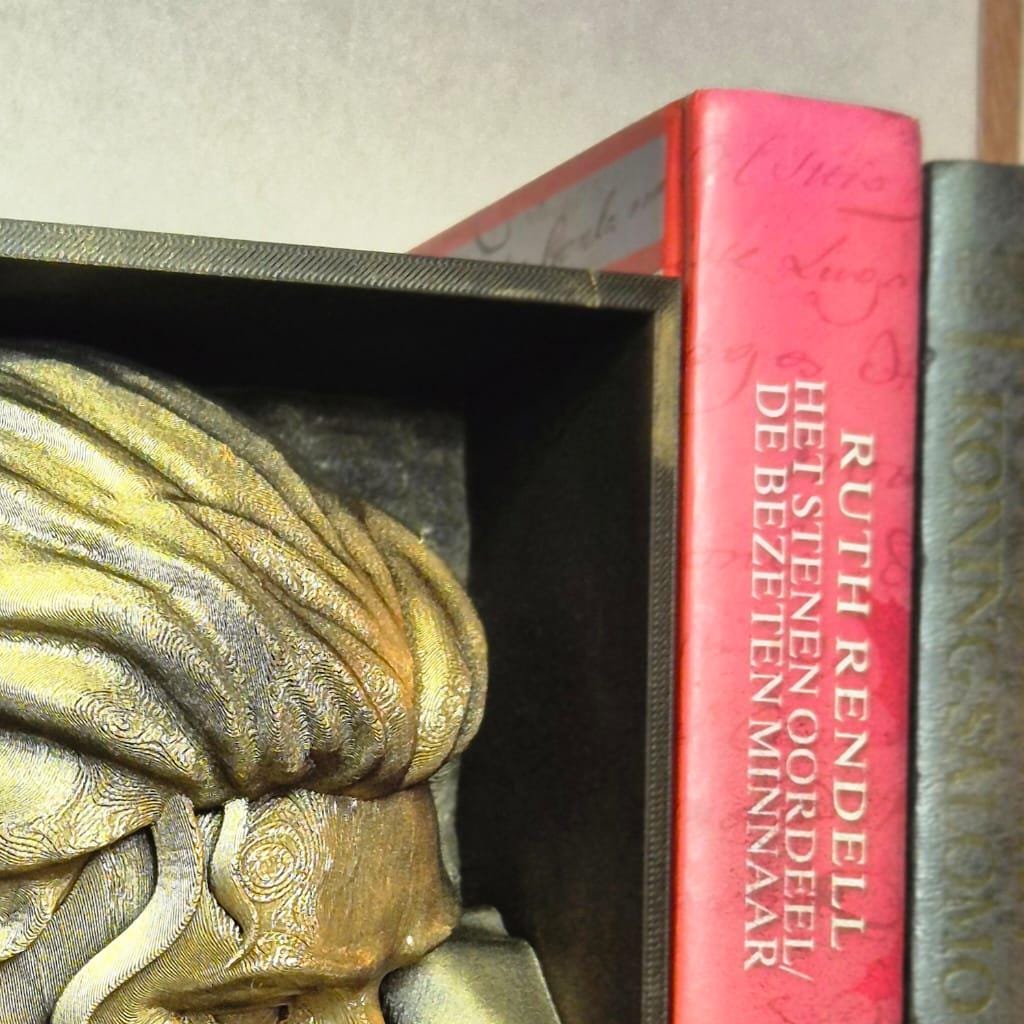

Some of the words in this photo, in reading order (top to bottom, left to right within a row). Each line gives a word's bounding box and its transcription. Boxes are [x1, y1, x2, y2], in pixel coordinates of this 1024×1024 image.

[753, 382, 790, 454] DE
[791, 378, 827, 486] HET
[835, 428, 875, 618] RUTH
[748, 465, 789, 705] BEZETEN
[787, 493, 824, 698] STENEN
[742, 718, 783, 972] MINNAAR
[778, 707, 819, 982] OORDEEL/
[830, 635, 871, 952] RENDELL
